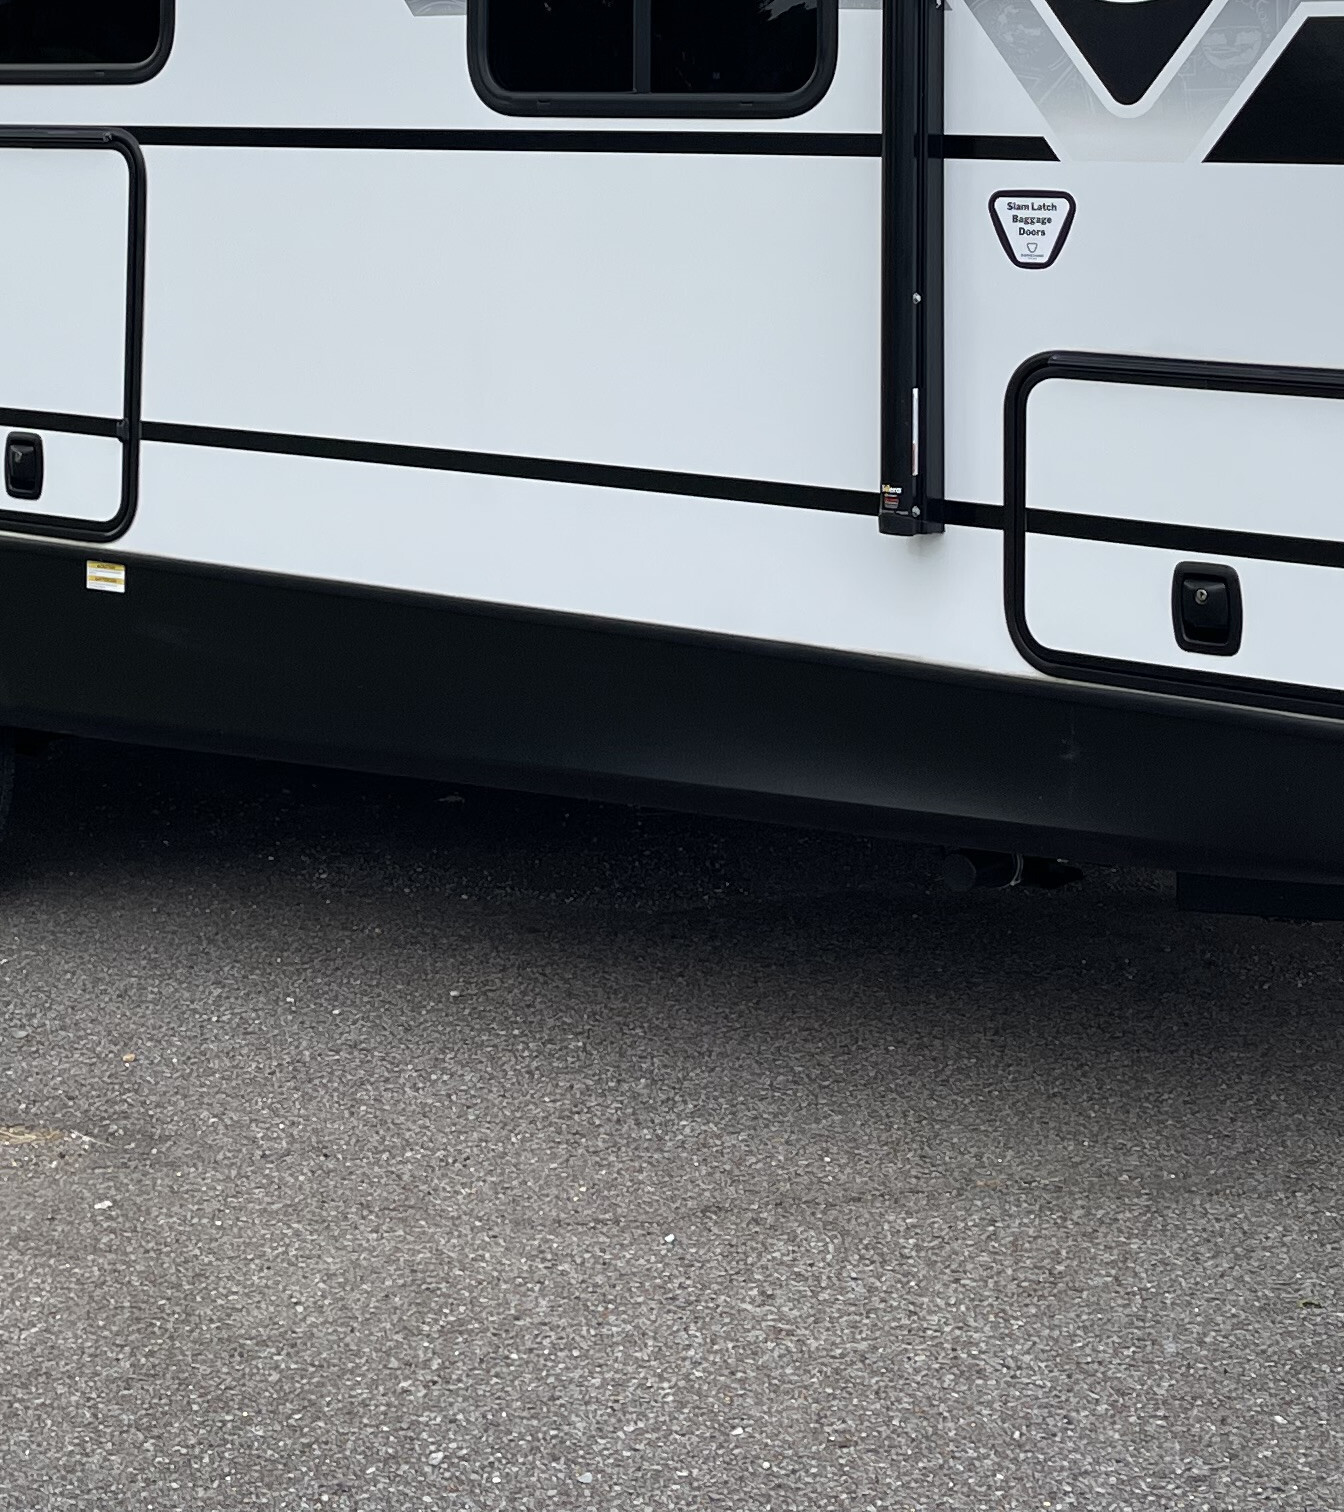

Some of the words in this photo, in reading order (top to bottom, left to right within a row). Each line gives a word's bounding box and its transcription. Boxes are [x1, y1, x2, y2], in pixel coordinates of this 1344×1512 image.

[1006, 201, 1030, 211] Slam
[1031, 202, 1058, 212] Latch
[1012, 214, 1053, 226] Baggage
[1018, 227, 1046, 237] Doors
